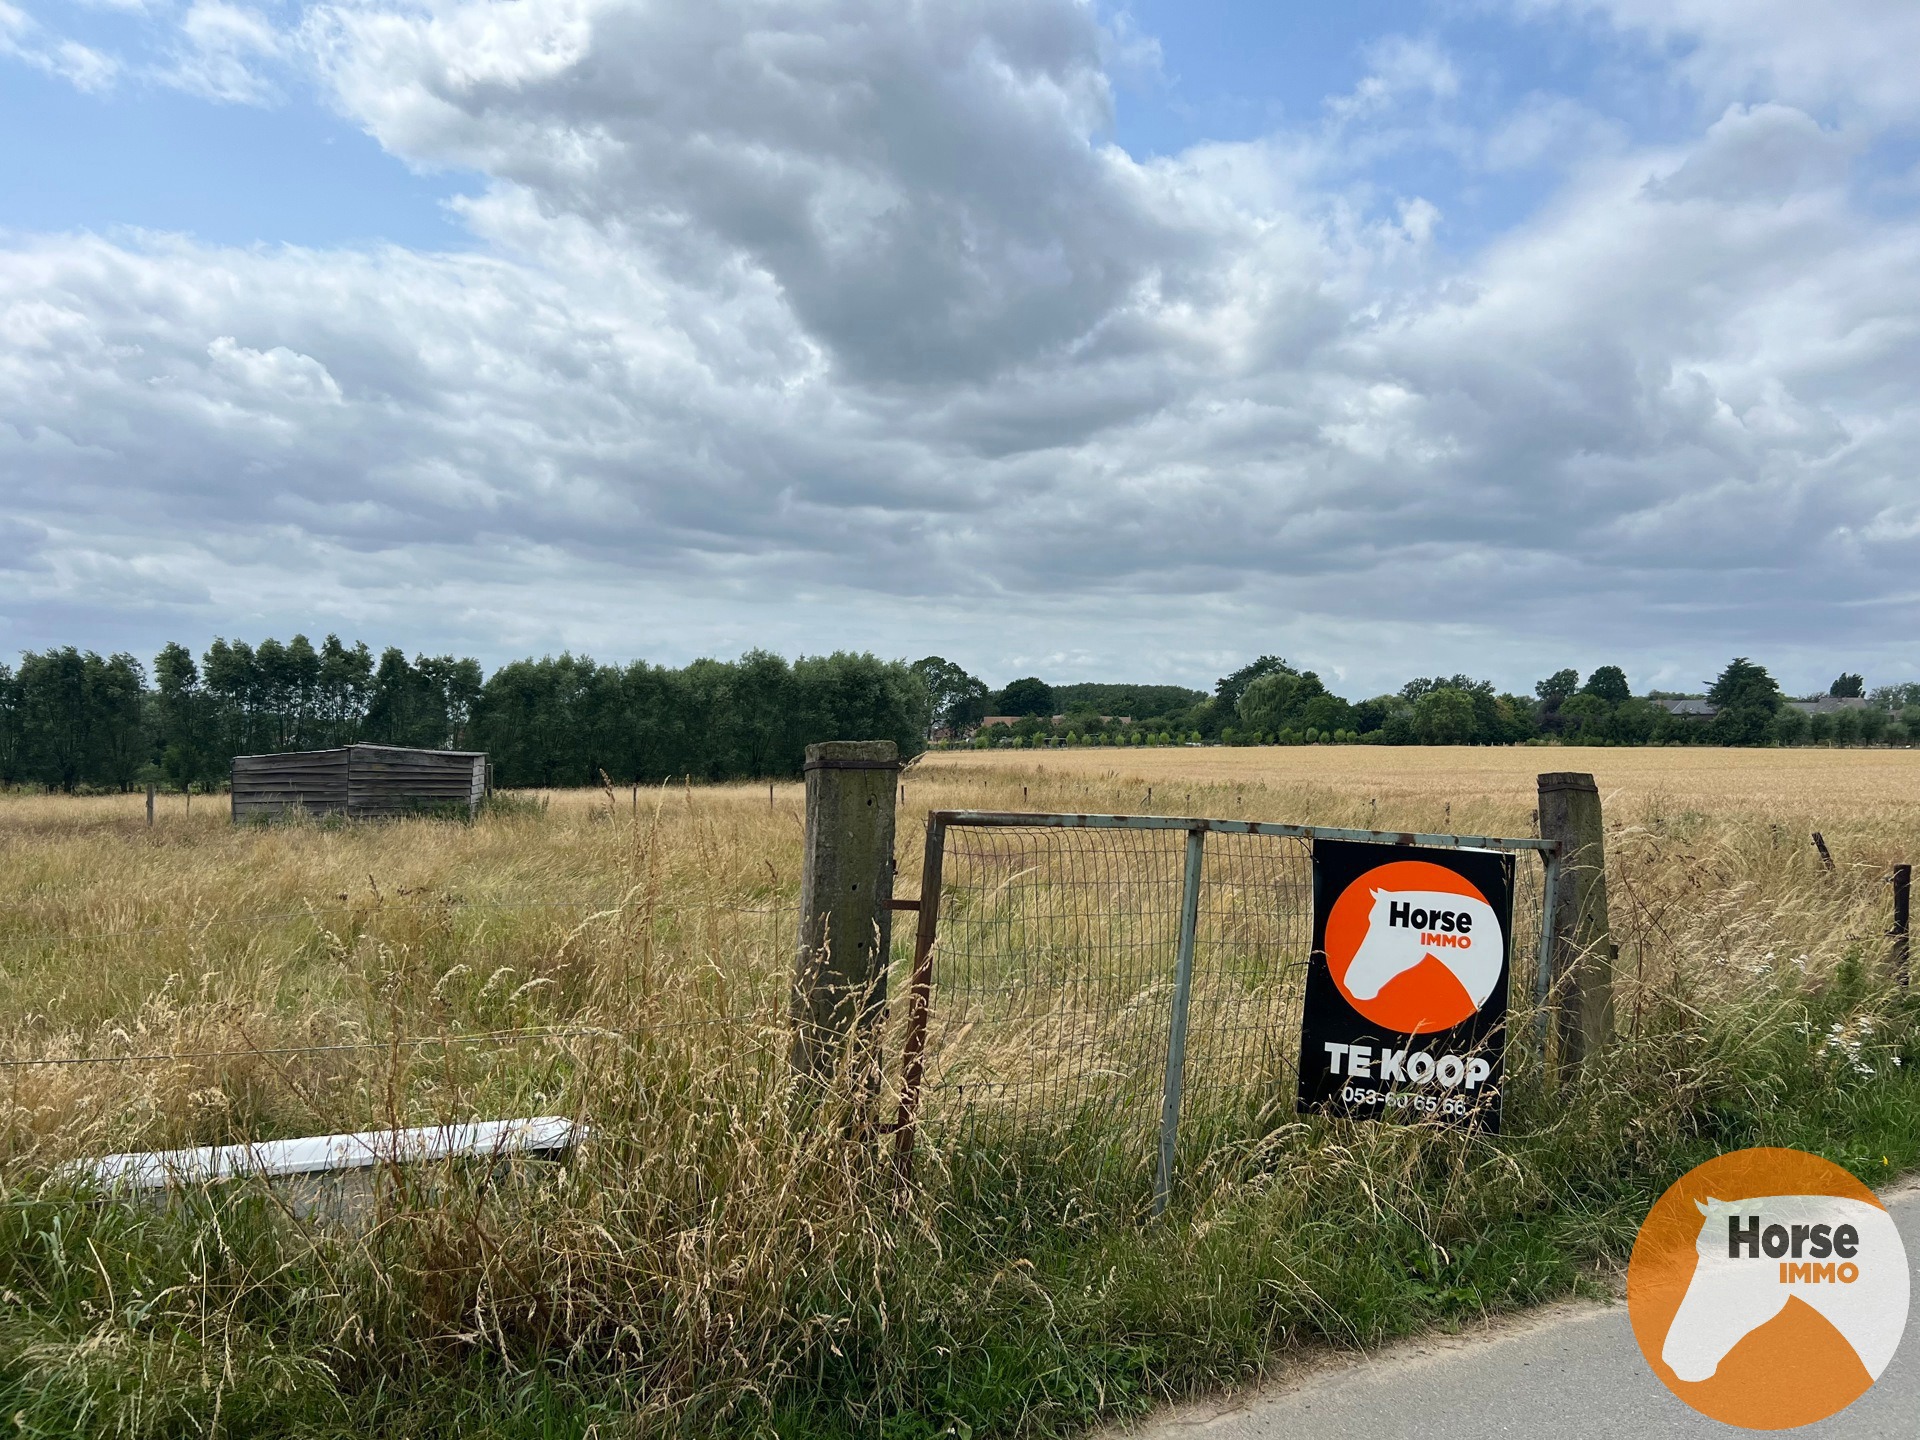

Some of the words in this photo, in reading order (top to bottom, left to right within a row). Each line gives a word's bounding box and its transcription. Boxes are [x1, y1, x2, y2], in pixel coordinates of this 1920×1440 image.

[1389, 900, 1472, 934] Horse
[1420, 932, 1472, 949] IMMO
[1324, 1041, 1372, 1078] TE
[1380, 1048, 1490, 1090] KOOP
